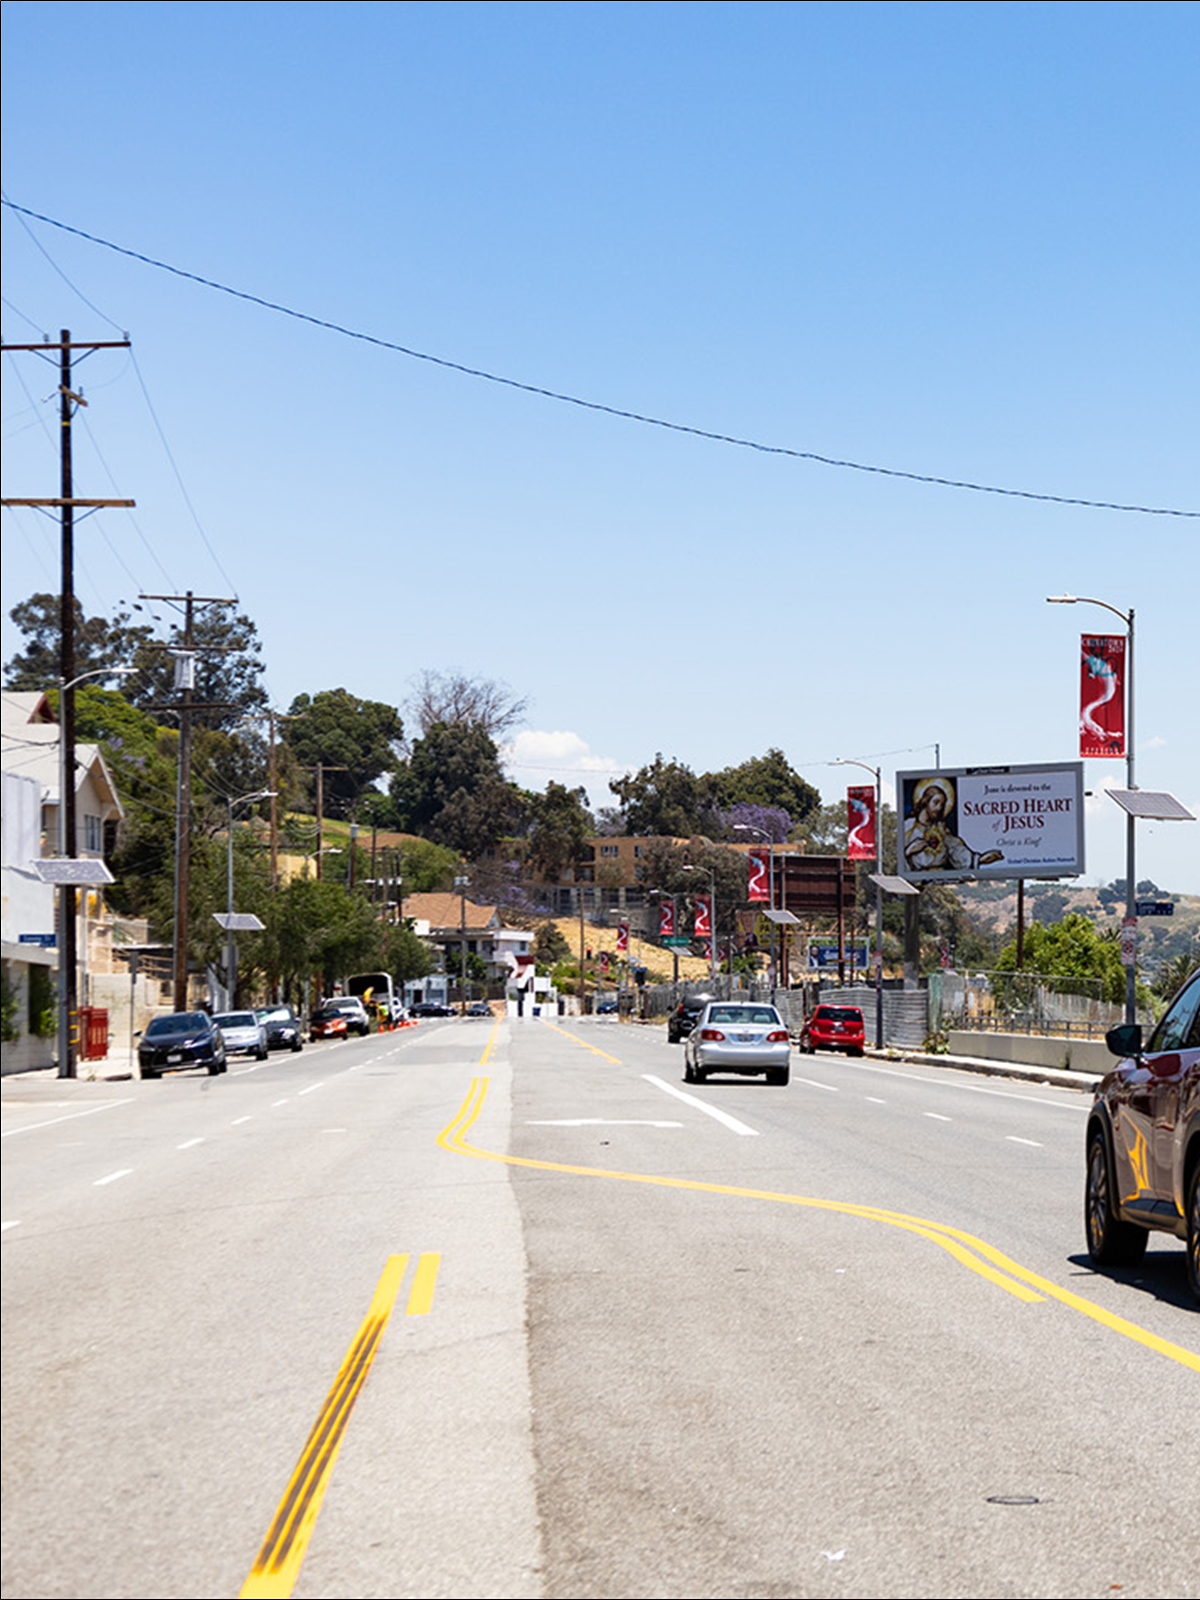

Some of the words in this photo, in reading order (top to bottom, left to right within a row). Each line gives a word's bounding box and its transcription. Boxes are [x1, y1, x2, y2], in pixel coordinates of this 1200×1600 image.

[1040, 782, 1051, 791] the
[963, 800, 1020, 817] SACRED
[1023, 797, 1073, 813] HEART
[1002, 814, 1045, 834] JESUS
